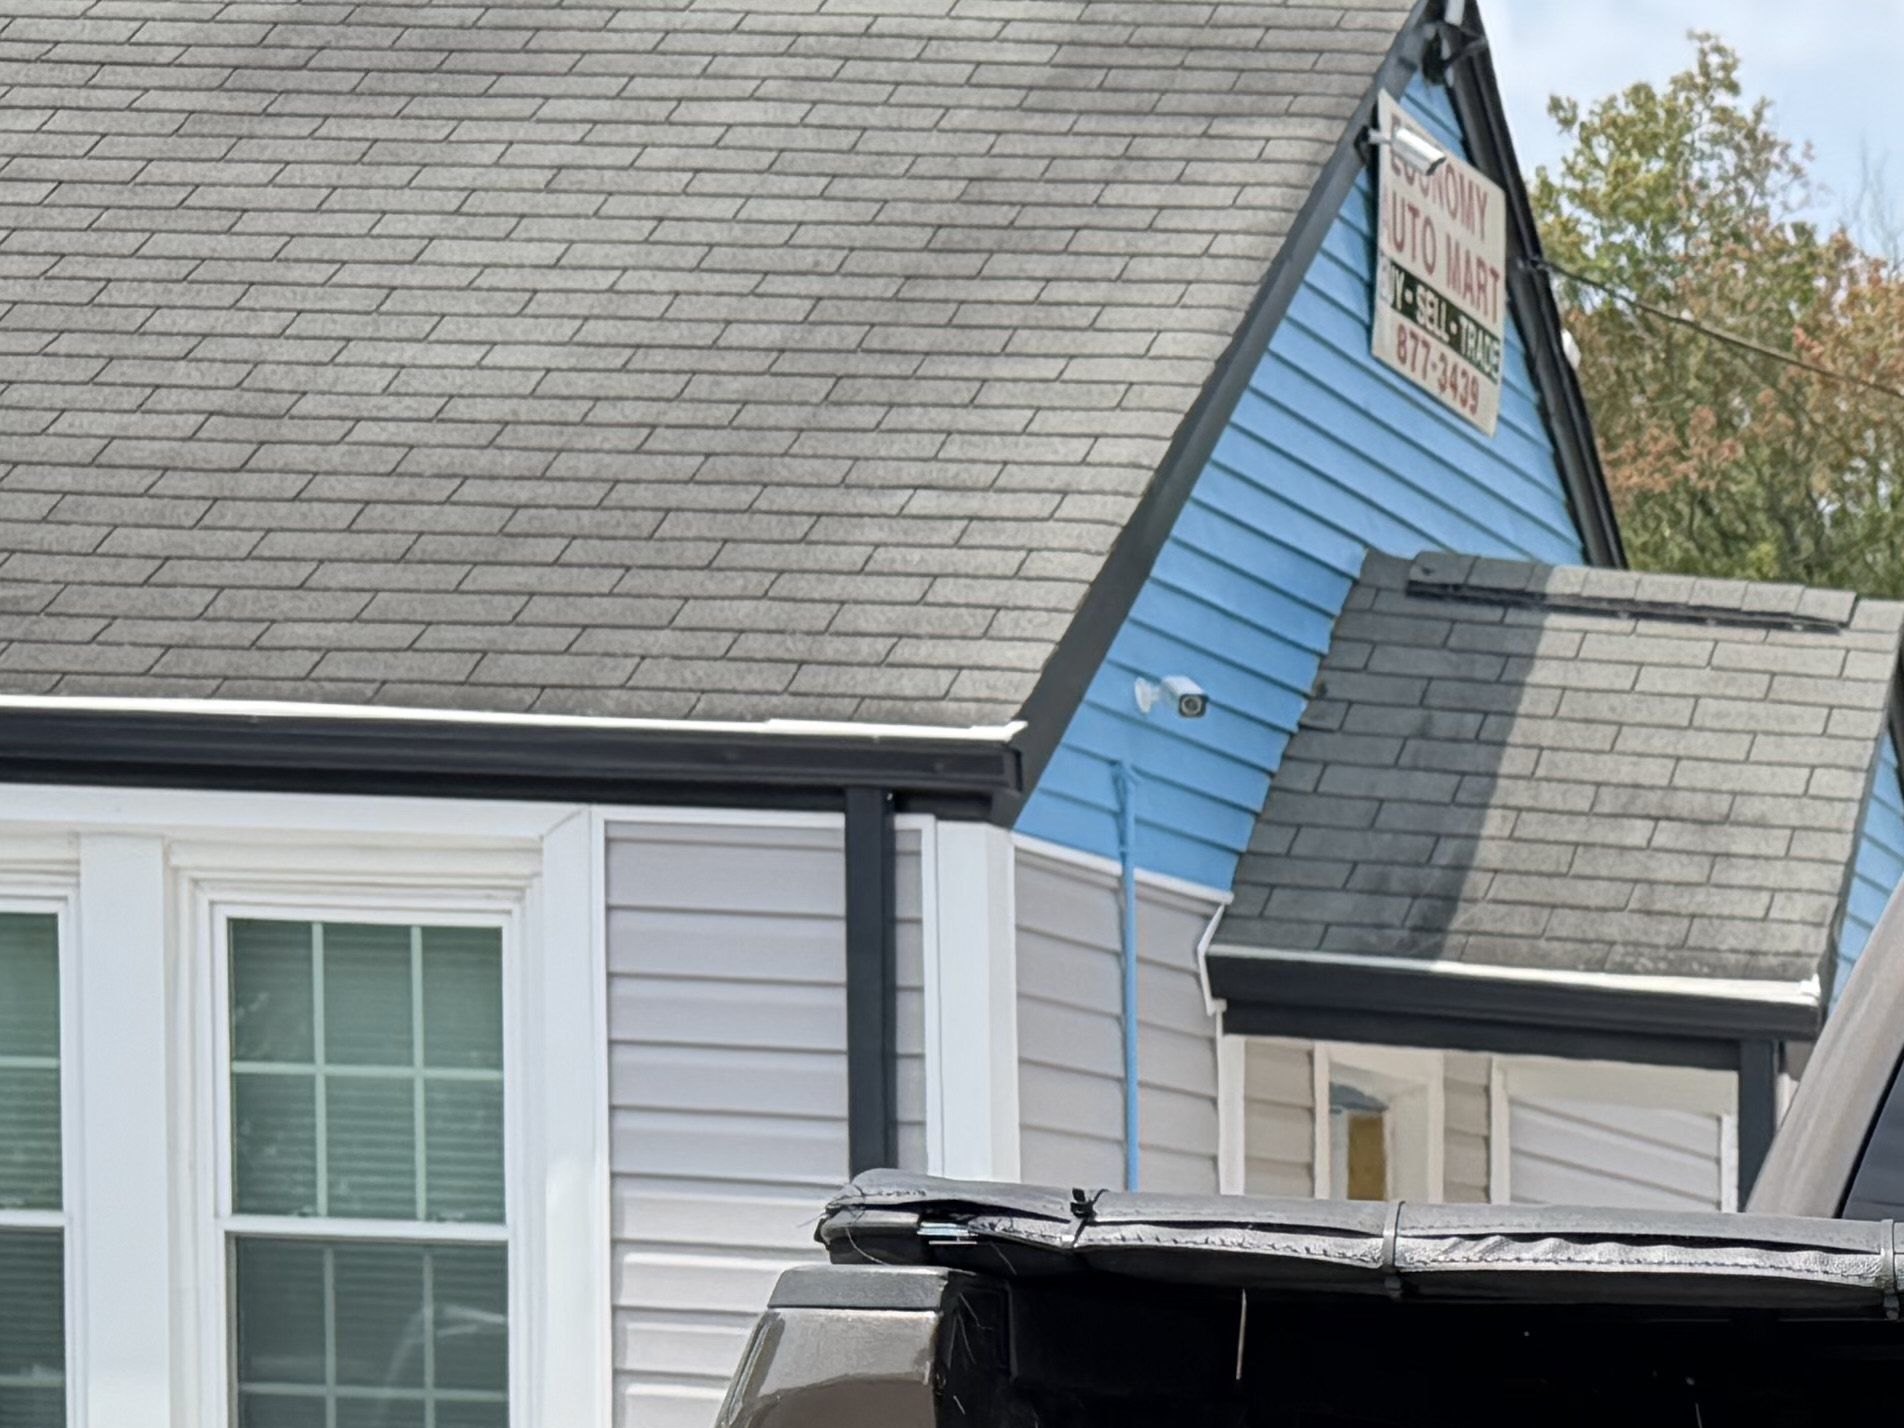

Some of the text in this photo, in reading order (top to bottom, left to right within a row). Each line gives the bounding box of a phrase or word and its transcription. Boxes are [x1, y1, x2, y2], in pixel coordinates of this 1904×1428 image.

[1416, 284, 1450, 343] SELL
[1446, 232, 1499, 324] MART
[1397, 322, 1480, 416] 877-3439
